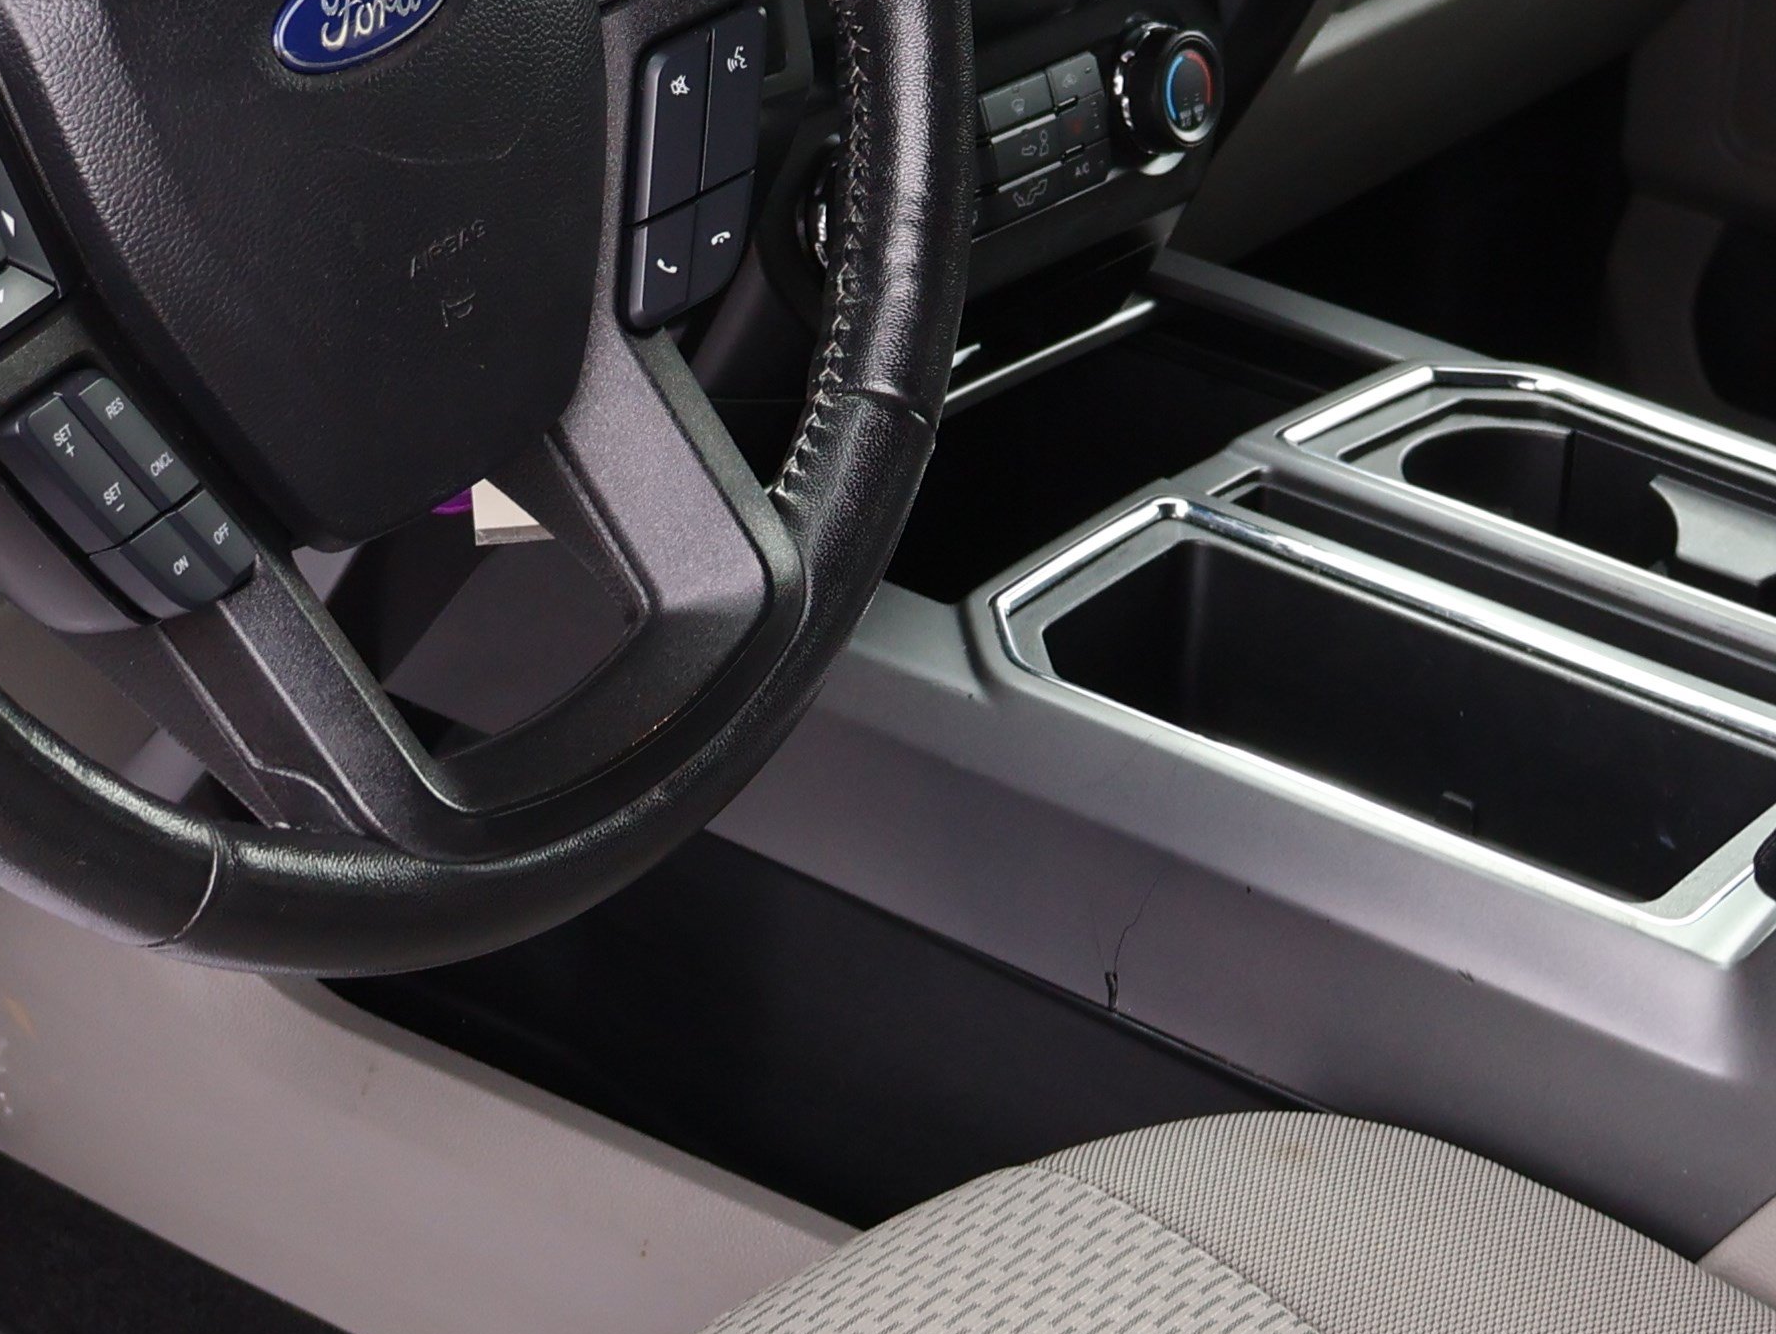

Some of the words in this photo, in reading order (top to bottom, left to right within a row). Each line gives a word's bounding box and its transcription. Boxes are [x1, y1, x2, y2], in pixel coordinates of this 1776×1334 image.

[105, 397, 125, 420] RES
[53, 423, 72, 447] SET
[150, 451, 174, 477] CNCL
[103, 482, 121, 505] SET
[213, 522, 230, 545] OFF
[173, 555, 189, 576] ON
